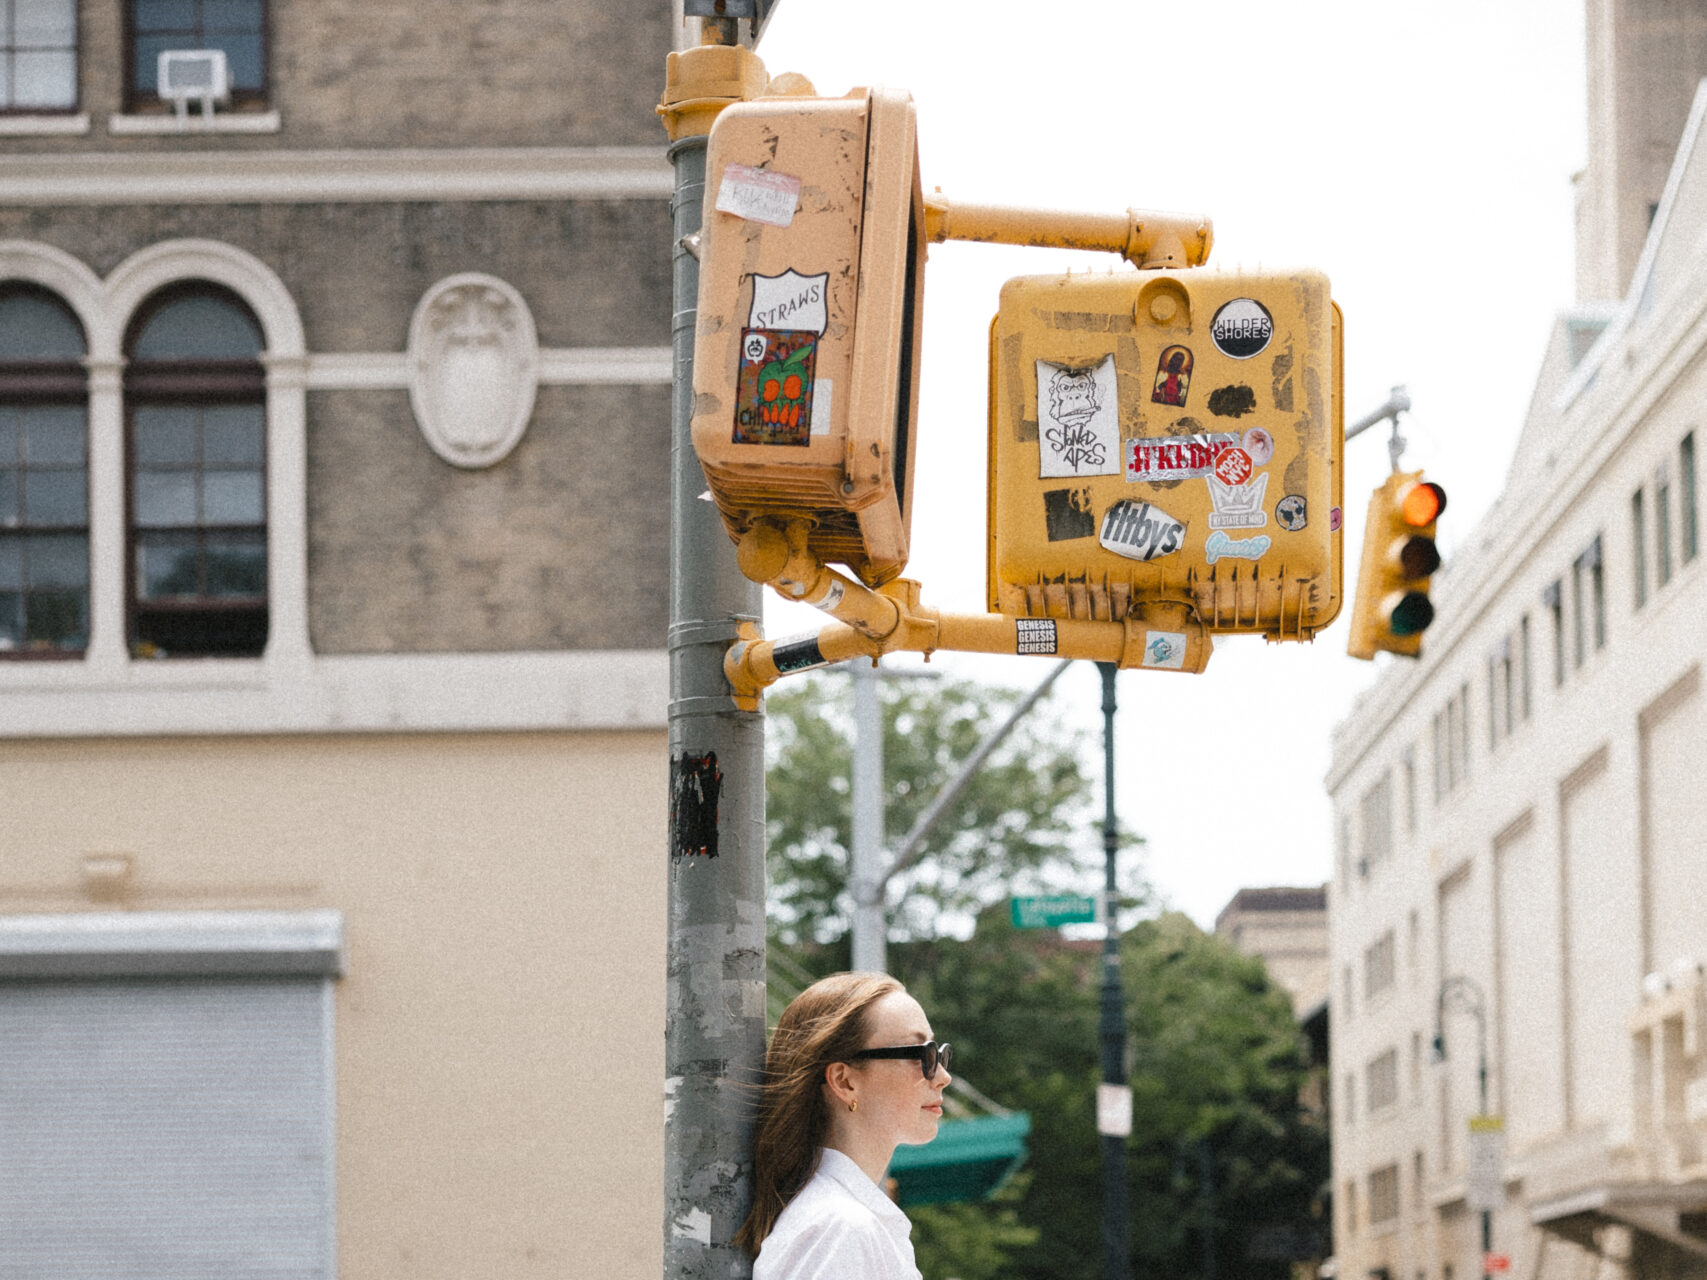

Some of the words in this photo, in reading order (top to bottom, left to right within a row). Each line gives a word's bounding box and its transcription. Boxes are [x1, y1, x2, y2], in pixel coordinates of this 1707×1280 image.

[757, 284, 819, 328] STRAWS
[1216, 317, 1270, 330] WILDER
[1215, 328, 1270, 340] SHORES
[1063, 443, 1106, 473] APES
[1222, 515, 1239, 525] STATE
[1017, 620, 1055, 631] GENESIS
[1018, 631, 1055, 643] GENESIS
[1018, 642, 1056, 653] GENESIS
